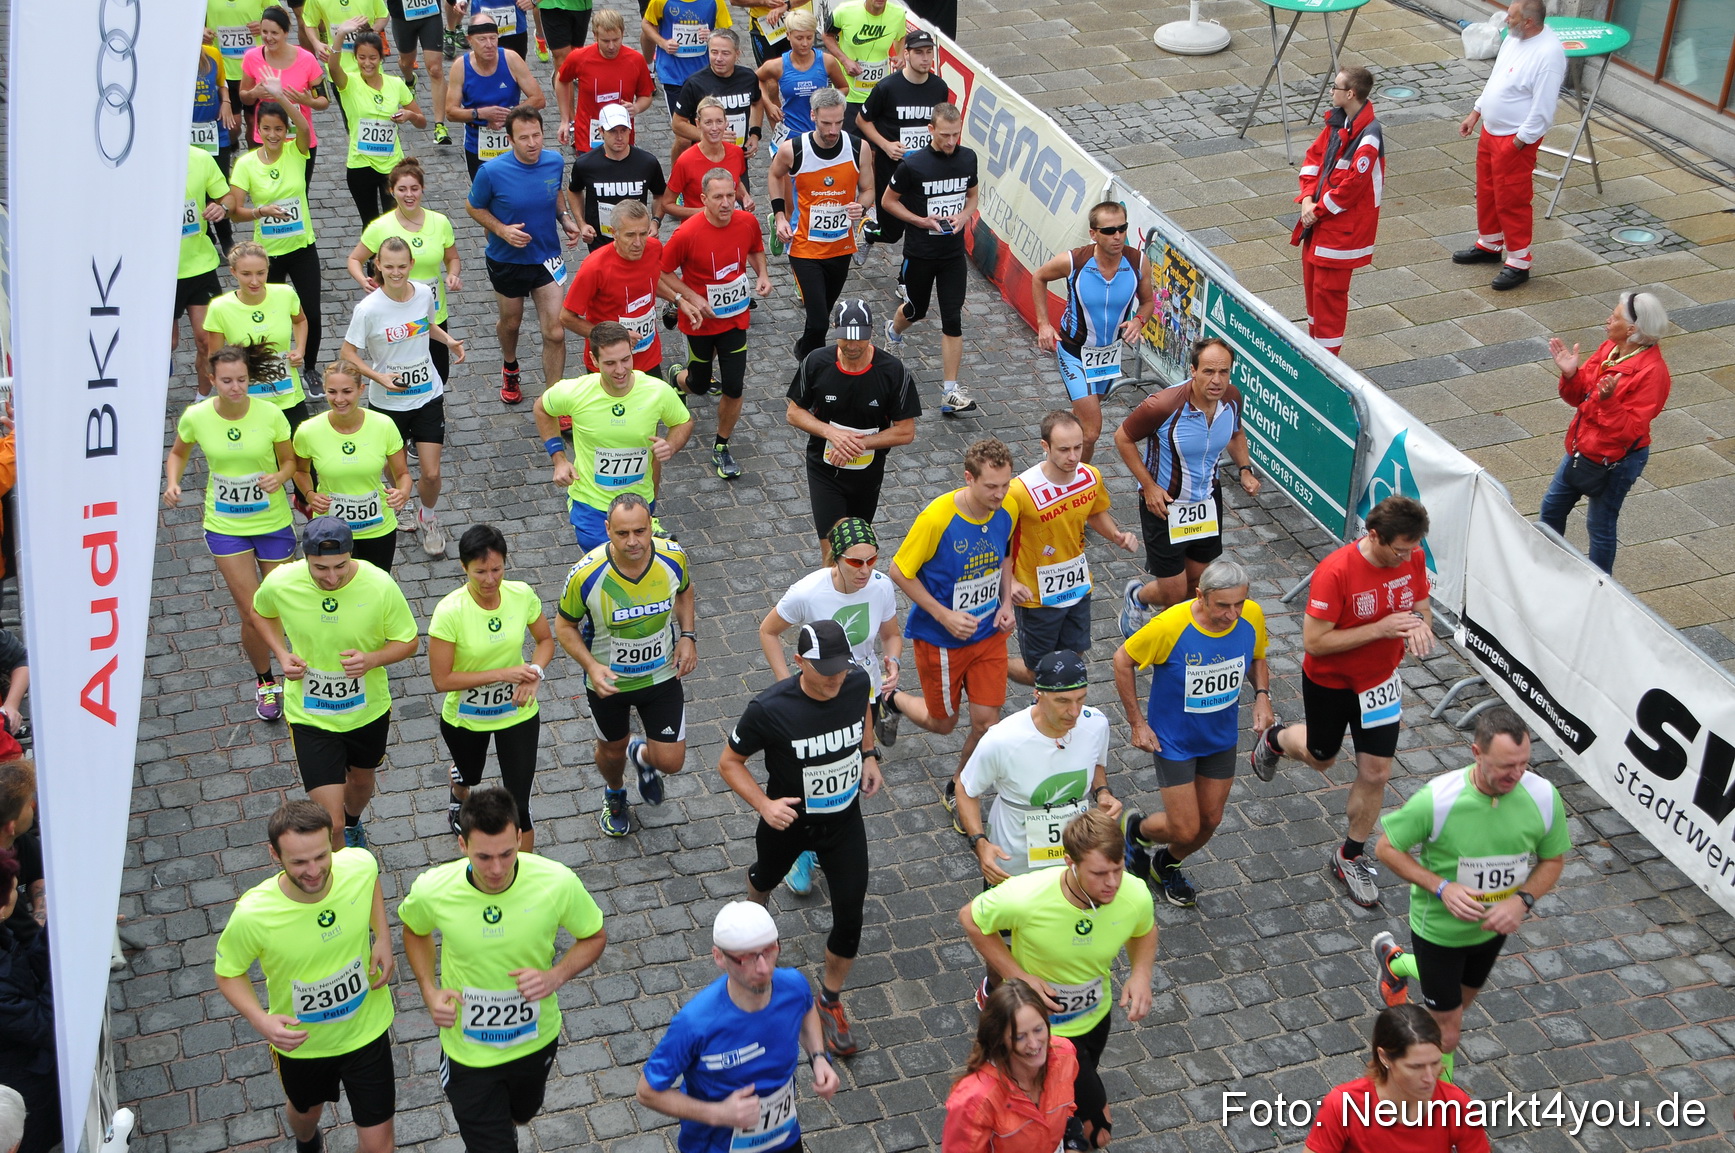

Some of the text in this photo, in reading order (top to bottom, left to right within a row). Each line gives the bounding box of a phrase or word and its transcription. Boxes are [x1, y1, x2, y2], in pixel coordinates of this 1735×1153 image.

[859, 24, 886, 37] RUN
[221, 33, 253, 47] 2755
[862, 68, 883, 81] 289
[362, 127, 393, 142] 2032
[486, 136, 510, 148] 310
[593, 181, 643, 197] THULE
[811, 189, 846, 197] SportScheck
[922, 178, 968, 195] THULE
[932, 202, 963, 219] 2678
[814, 213, 847, 229] 2582
[272, 226, 293, 234] Nadine
[713, 285, 747, 307] 2624
[724, 305, 740, 313] Peter
[627, 319, 654, 338] 492
[1228, 312, 1298, 380] Event-Leit-Systeme
[1084, 350, 1117, 367] 2127
[1240, 362, 1299, 430] Sicherheit
[1242, 394, 1281, 443] Event!
[599, 458, 644, 476] 2777
[1251, 442, 1269, 467] Line:
[1270, 460, 1293, 489] 09181
[1293, 480, 1314, 506] 6352
[613, 477, 627, 485] Ralf
[79, 253, 123, 728] Audi BKK
[218, 485, 264, 503] 2478
[229, 505, 254, 513] Carina
[334, 501, 378, 520] 2550
[1039, 490, 1098, 523] MAX BÖGL
[1178, 503, 1207, 524] 250
[1184, 525, 1202, 534] Oliver
[1038, 569, 1056, 577] PARTL
[1044, 567, 1085, 594] 2794
[959, 583, 997, 610] 2496
[1055, 590, 1077, 603] Stefan
[612, 599, 671, 622] BOCK
[489, 633, 506, 642] Partl
[612, 636, 660, 647] PARTL Neumarkt
[616, 643, 662, 663] 2906
[623, 663, 655, 674] Manfred
[1186, 664, 1236, 676] PARTL Neumarkt
[308, 679, 361, 698] 2434
[1191, 670, 1239, 695] 2606
[466, 684, 514, 706] 2163
[1200, 694, 1229, 706] Richard
[1365, 679, 1401, 709] 3320
[315, 700, 354, 710] Johannes
[475, 707, 503, 715] Andrea
[1511, 673, 1528, 692] die
[1530, 687, 1579, 743] verbinden
[791, 721, 862, 760] THULE
[804, 760, 855, 778] PARTL Neumarkt
[811, 764, 859, 796] 2079
[824, 793, 852, 807] Jeroen
[1026, 810, 1080, 822] PARTL Neumarkt
[1614, 762, 1735, 888] stadtwer
[1473, 868, 1516, 890] 195
[321, 925, 341, 940] Partl
[482, 926, 504, 935] Partl
[1072, 935, 1092, 944] Partl
[293, 968, 353, 994] PARTL Neumarkt
[300, 972, 362, 1012] 2300
[464, 993, 489, 1002] PARTL
[323, 1005, 350, 1019] Peter
[470, 1002, 534, 1026] 2225
[481, 1030, 521, 1042] Dominik
[742, 1094, 791, 1133] 179
